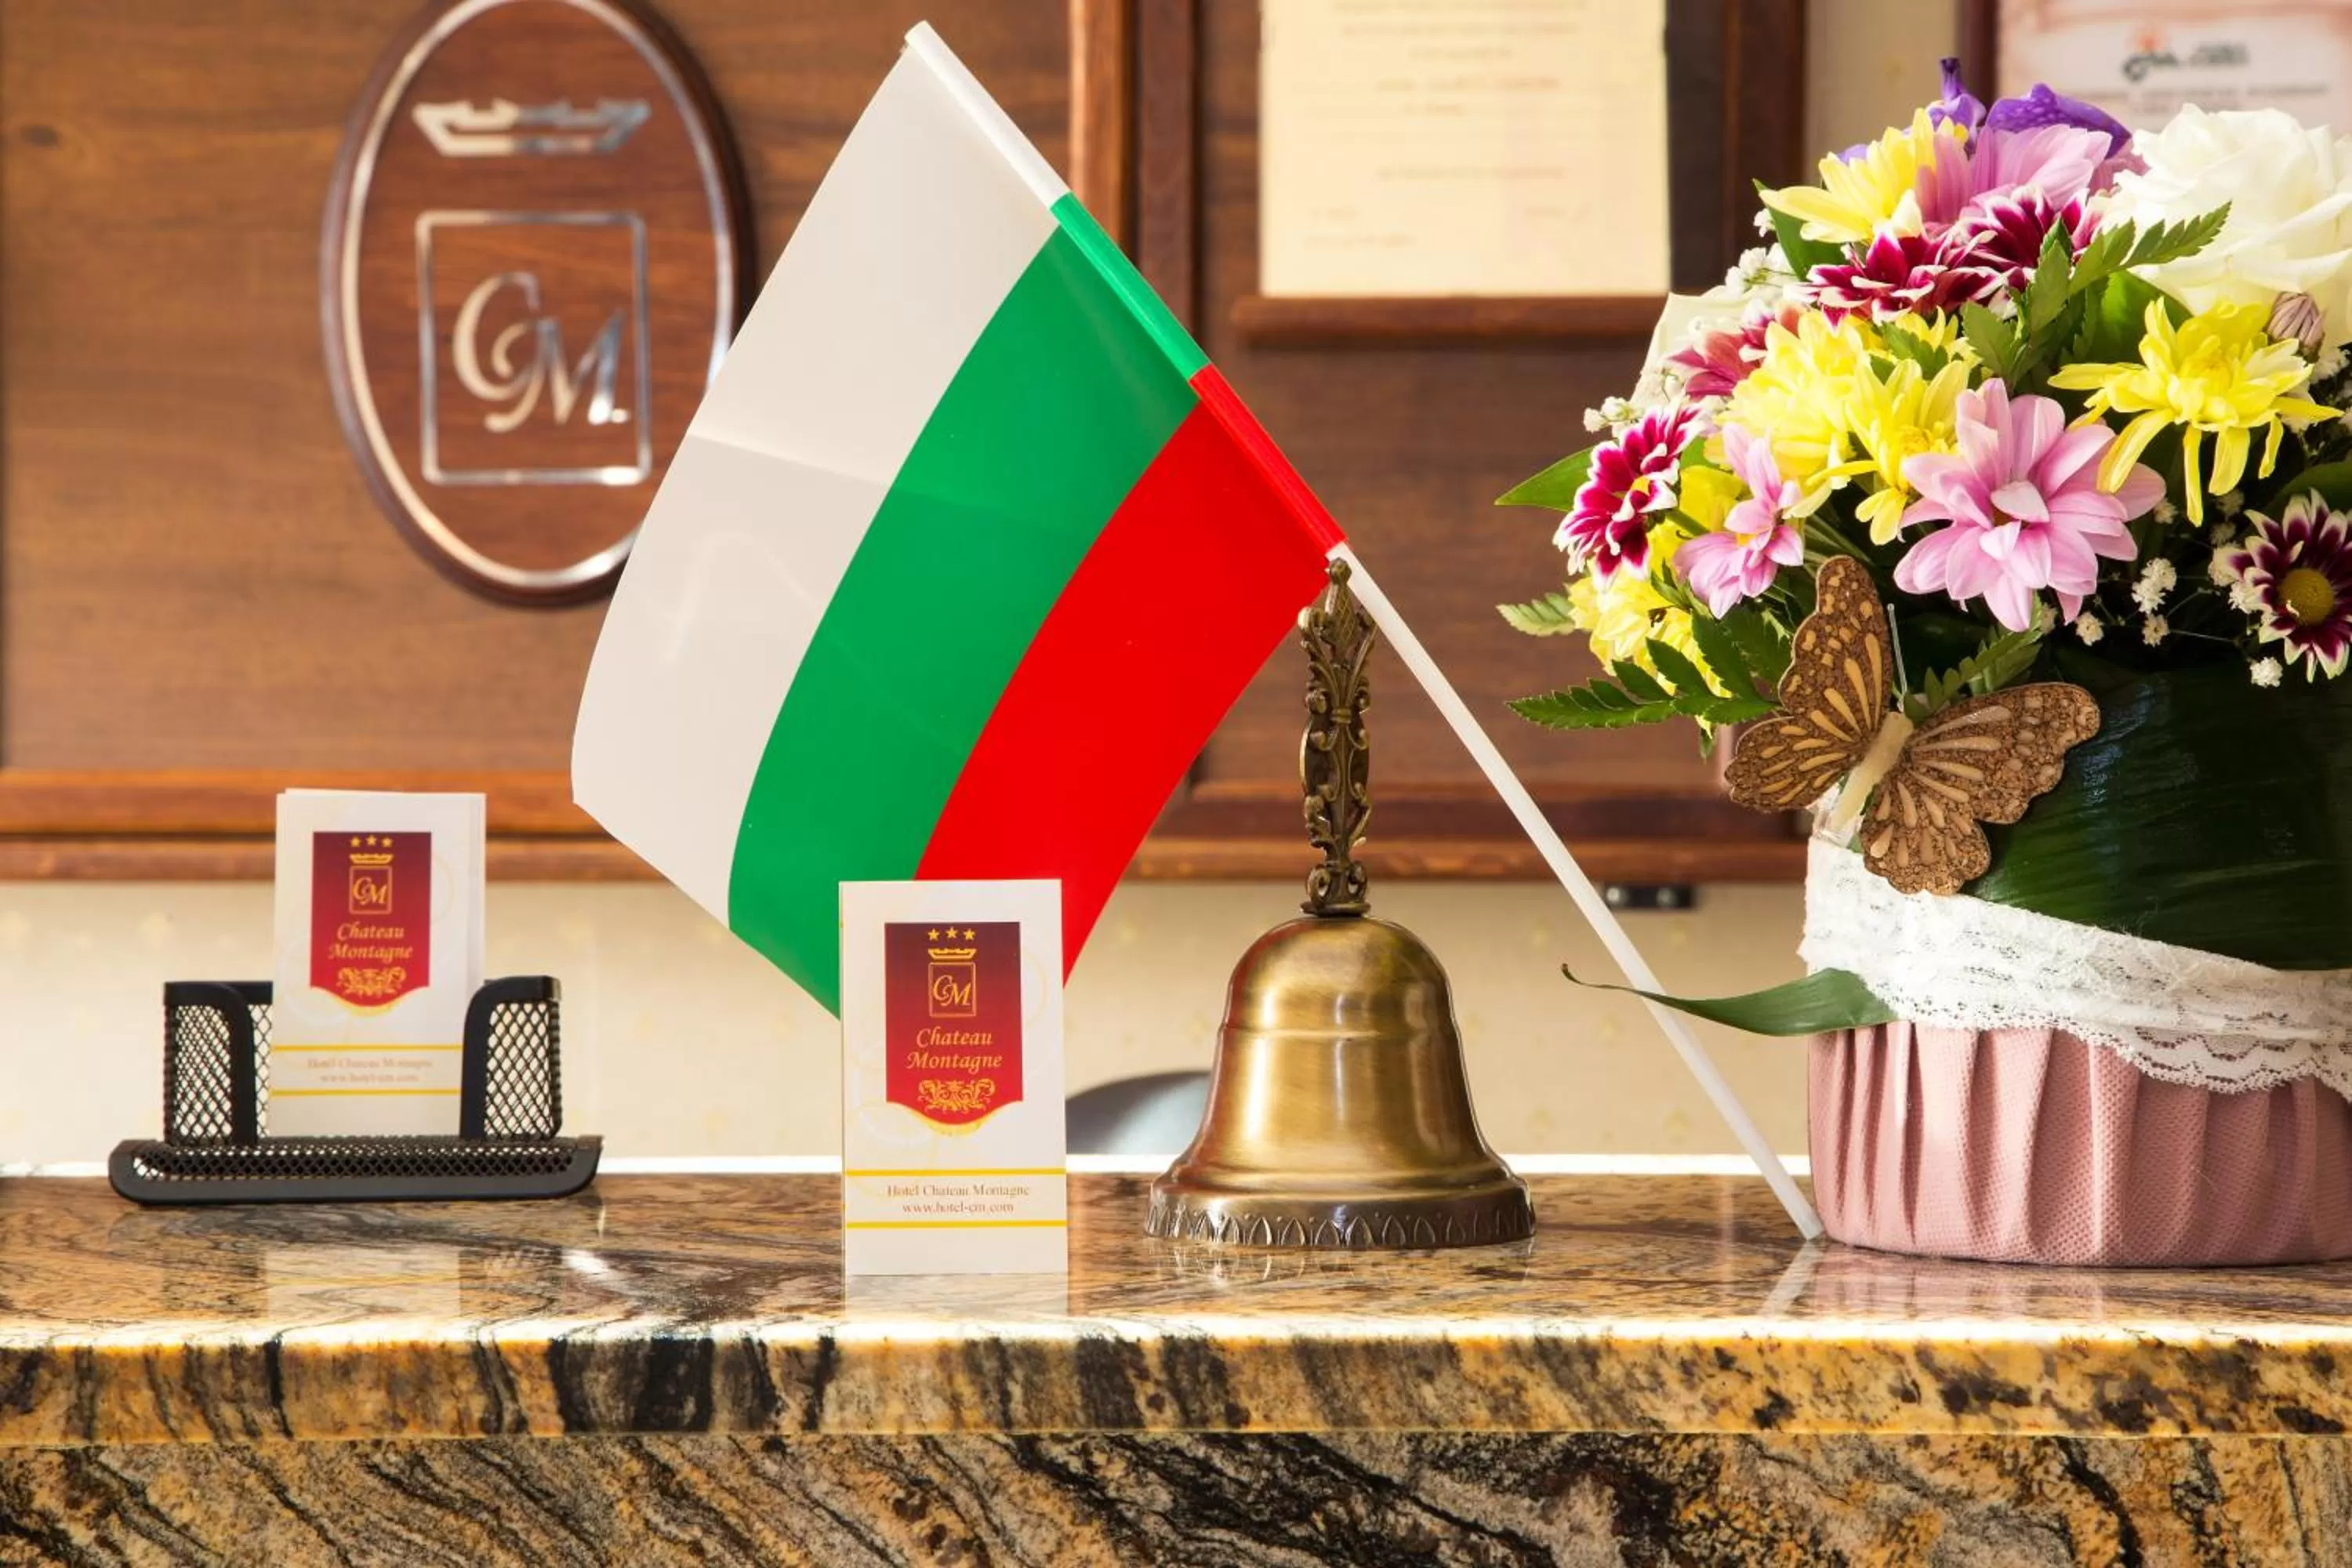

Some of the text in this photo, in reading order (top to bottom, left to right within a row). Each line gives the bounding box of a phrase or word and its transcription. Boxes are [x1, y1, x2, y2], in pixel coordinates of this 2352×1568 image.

[336, 921, 405, 941] Chateau
[328, 943, 413, 964] Montagne
[916, 1025, 993, 1048] Chateau
[906, 1051, 1003, 1075] Montagne
[887, 1185, 1029, 1200] Hotel Chateau Montagne
[902, 1201, 1014, 1214] www.hotel-cm.com
